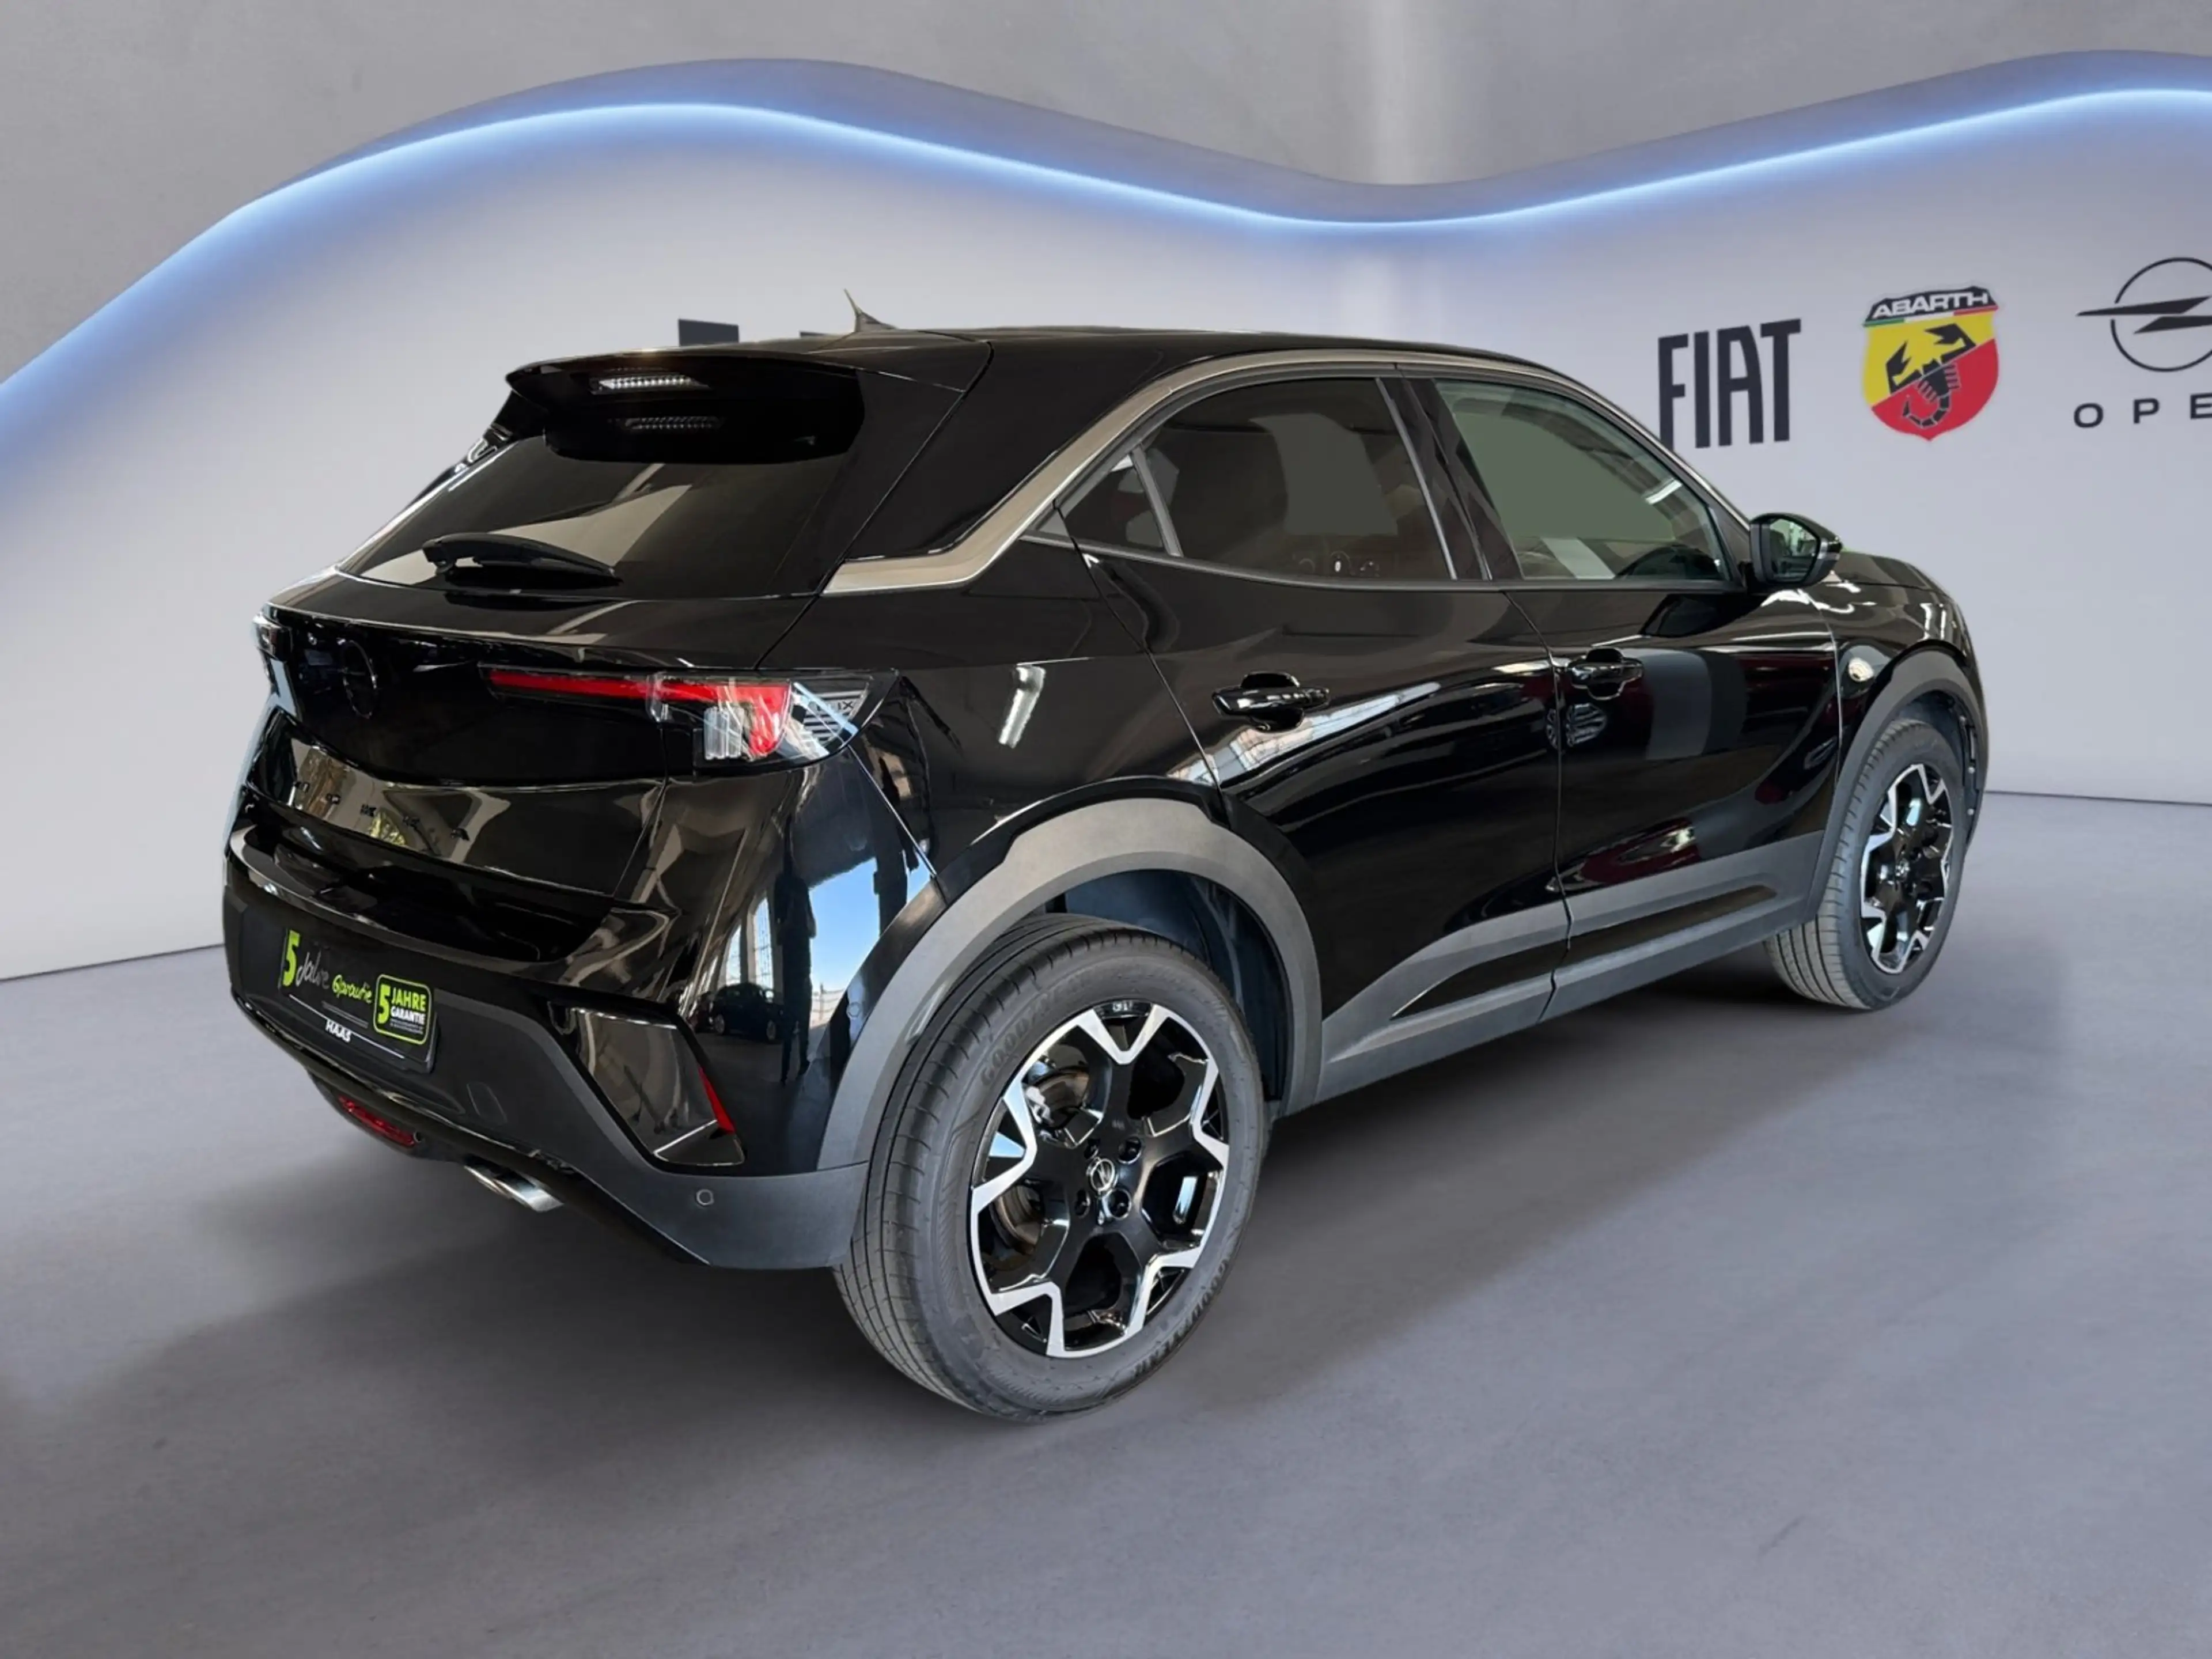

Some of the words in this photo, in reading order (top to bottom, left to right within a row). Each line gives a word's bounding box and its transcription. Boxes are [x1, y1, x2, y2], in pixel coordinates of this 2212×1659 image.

[1872, 291, 1989, 319] ABARTH
[1657, 318, 1801, 452] FIAT
[282, 929, 301, 987] 5
[377, 983, 391, 1024] 5
[391, 987, 427, 1012] JAHRE
[391, 1005, 426, 1025] GARANTIE
[325, 1018, 351, 1043] HAAS
